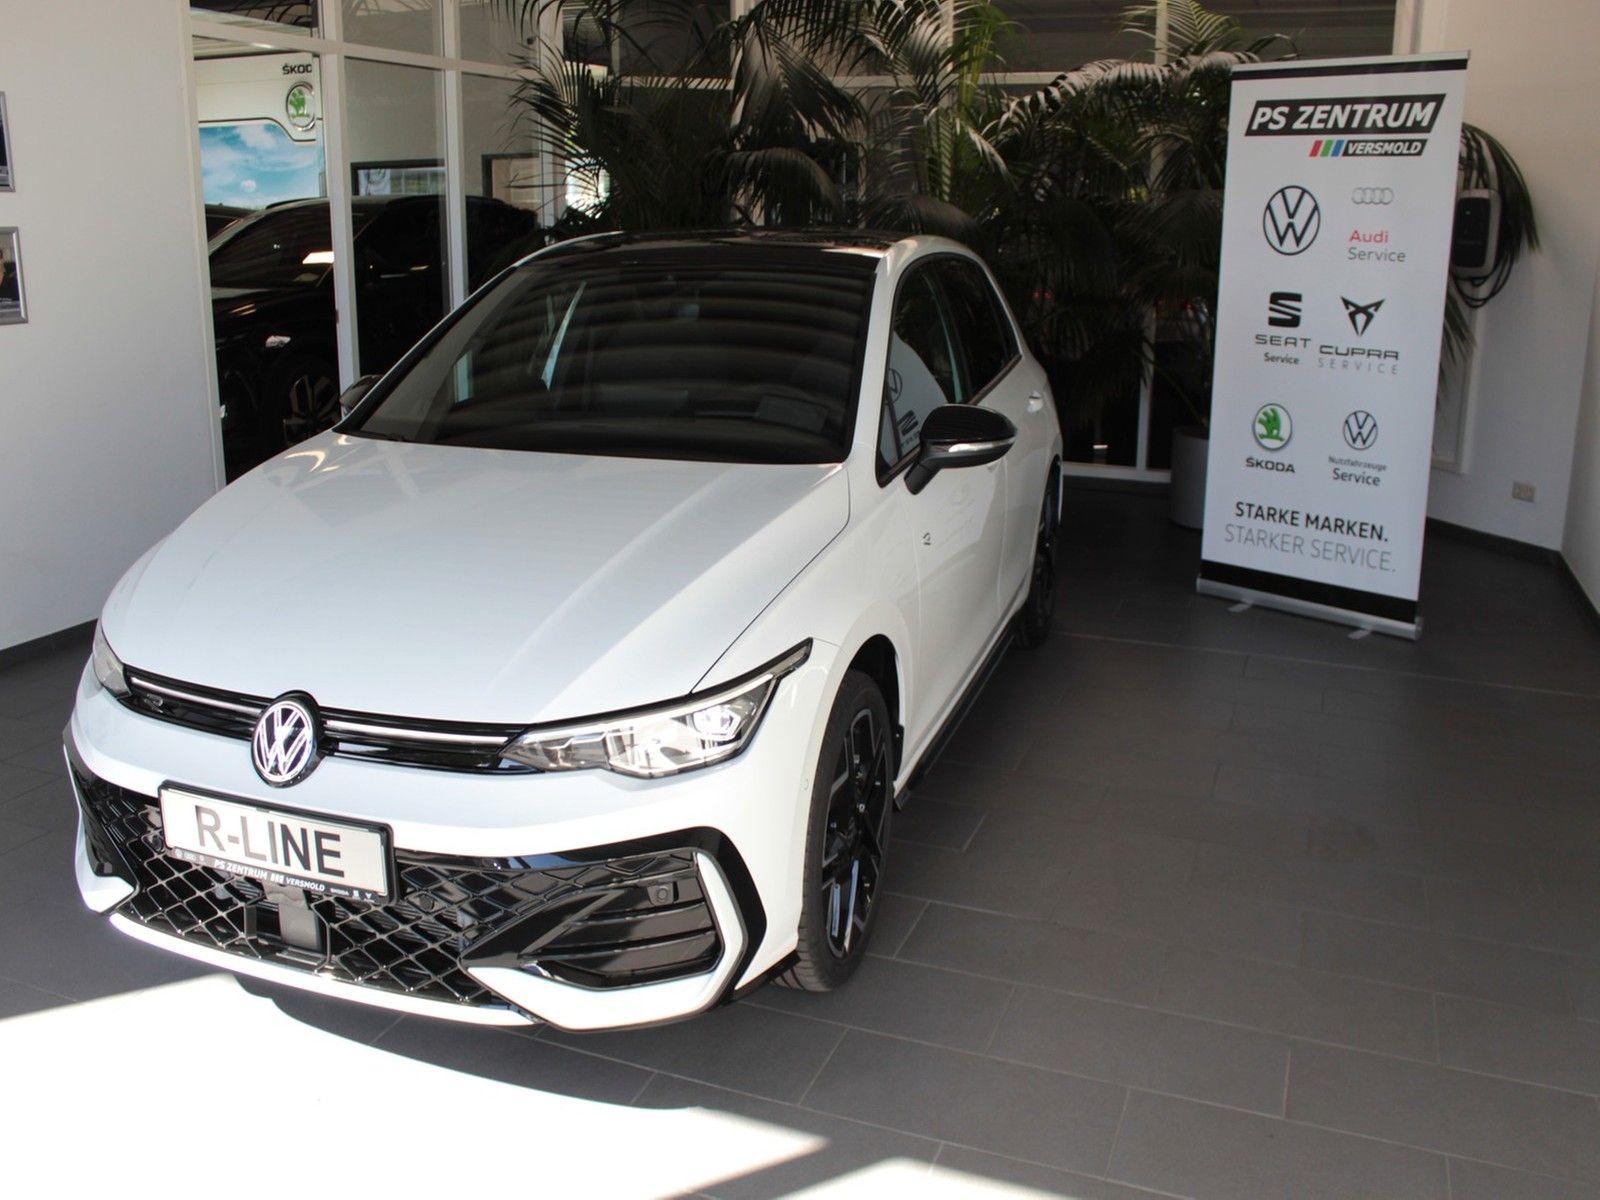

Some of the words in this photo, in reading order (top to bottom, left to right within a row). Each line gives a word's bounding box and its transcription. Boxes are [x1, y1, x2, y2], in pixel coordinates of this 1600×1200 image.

[282, 62, 313, 75] ŠKOD
[1251, 106, 1290, 131] PS
[1291, 101, 1437, 129] ZENTRUM
[1347, 141, 1422, 155] VERSMOLD
[1349, 230, 1389, 244] Audi
[1347, 247, 1407, 263] Service
[1255, 334, 1311, 348] SEAT
[1264, 352, 1300, 365] Service
[1319, 345, 1400, 360] CUPRA
[1318, 357, 1399, 376] SERVICE
[1246, 455, 1296, 473] ŠKODA
[1332, 467, 1381, 486] Service
[1235, 501, 1300, 527] STARKE
[1304, 512, 1389, 542] MARKEN.
[1224, 524, 1305, 555] STARKER
[1310, 538, 1397, 573] SERVICE.
[194, 805, 345, 878] R-LINE
[214, 859, 226, 870] PS
[226, 863, 268, 880] ZENTRUM
